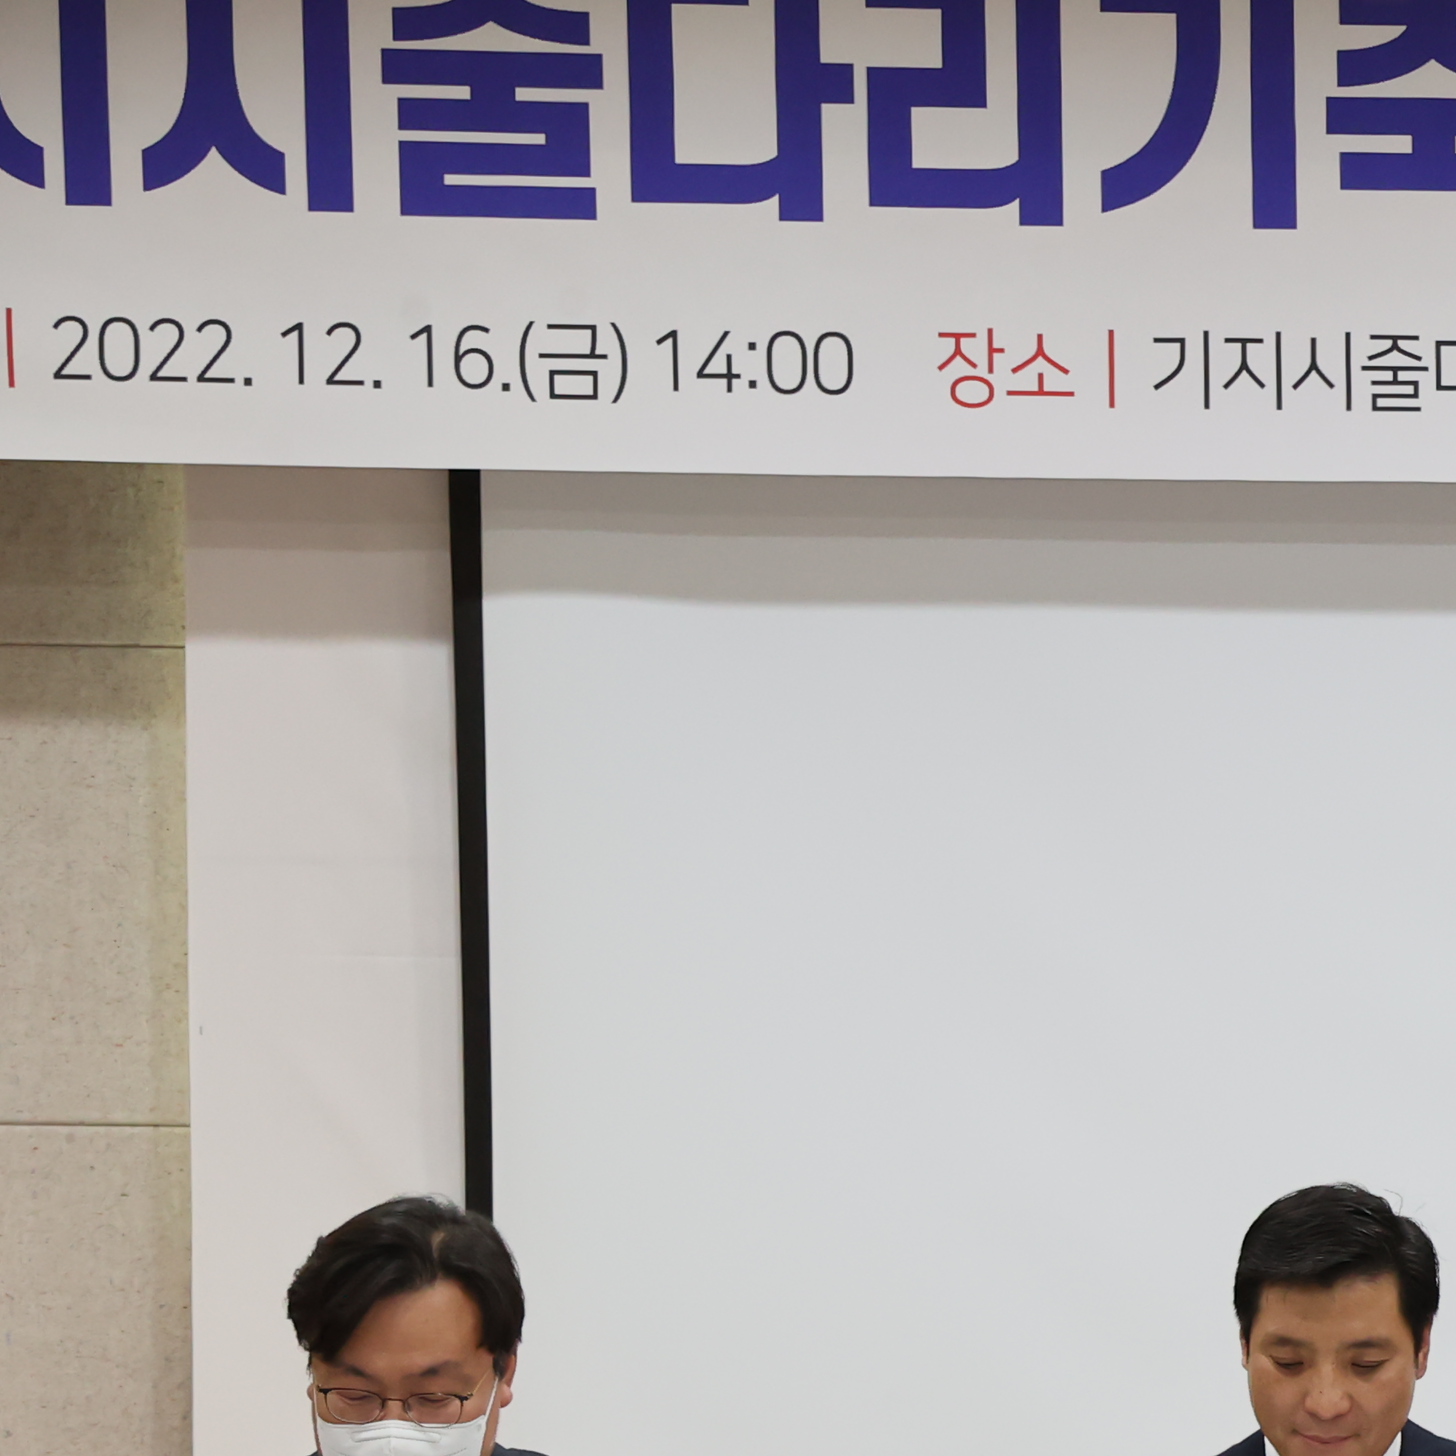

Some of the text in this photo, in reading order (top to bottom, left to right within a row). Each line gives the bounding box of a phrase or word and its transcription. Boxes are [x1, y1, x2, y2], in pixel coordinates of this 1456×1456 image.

[53, 316, 254, 388] 2022.
[281, 322, 383, 391] 12.
[656, 330, 855, 397] 14:00
[938, 328, 1076, 410] 장소
